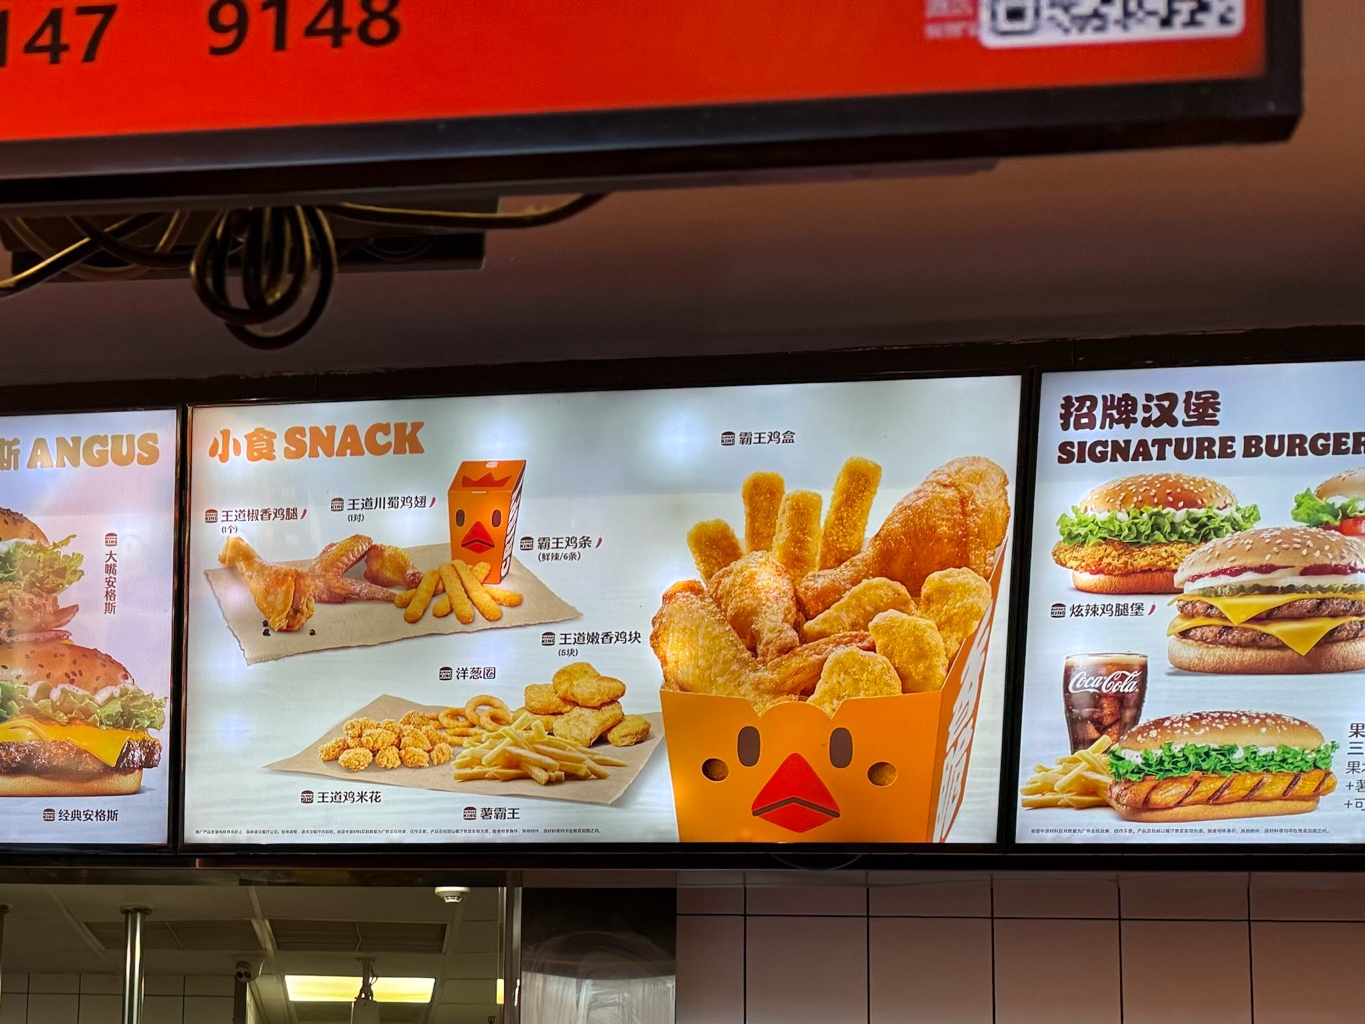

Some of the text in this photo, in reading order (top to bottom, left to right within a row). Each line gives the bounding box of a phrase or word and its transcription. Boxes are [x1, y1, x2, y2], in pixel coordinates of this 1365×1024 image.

[207, 0, 402, 55] 9148
[1059, 390, 1221, 431] 招牌汉堡
[209, 422, 425, 463] 小食 SNACK
[739, 430, 796, 445] 霸王鸡盒
[26, 432, 160, 469] ANGUS
[1057, 436, 1236, 464] SIGNATURE
[347, 496, 427, 511] 王道川蜀鸡翅
[221, 508, 299, 522] 王道椒香鸡腿
[537, 536, 592, 551] 霸王鸡条
[104, 550, 118, 615] 大嘴安格斯
[1070, 603, 1145, 617] 炫辣鸡腿堡
[559, 632, 642, 646] 王道嫩香鸡块
[456, 666, 496, 680] 洋葱圈
[317, 791, 382, 804] 王道鸡米花
[58, 809, 119, 821] 经典安格斯
[480, 807, 520, 821] 薯霸王
